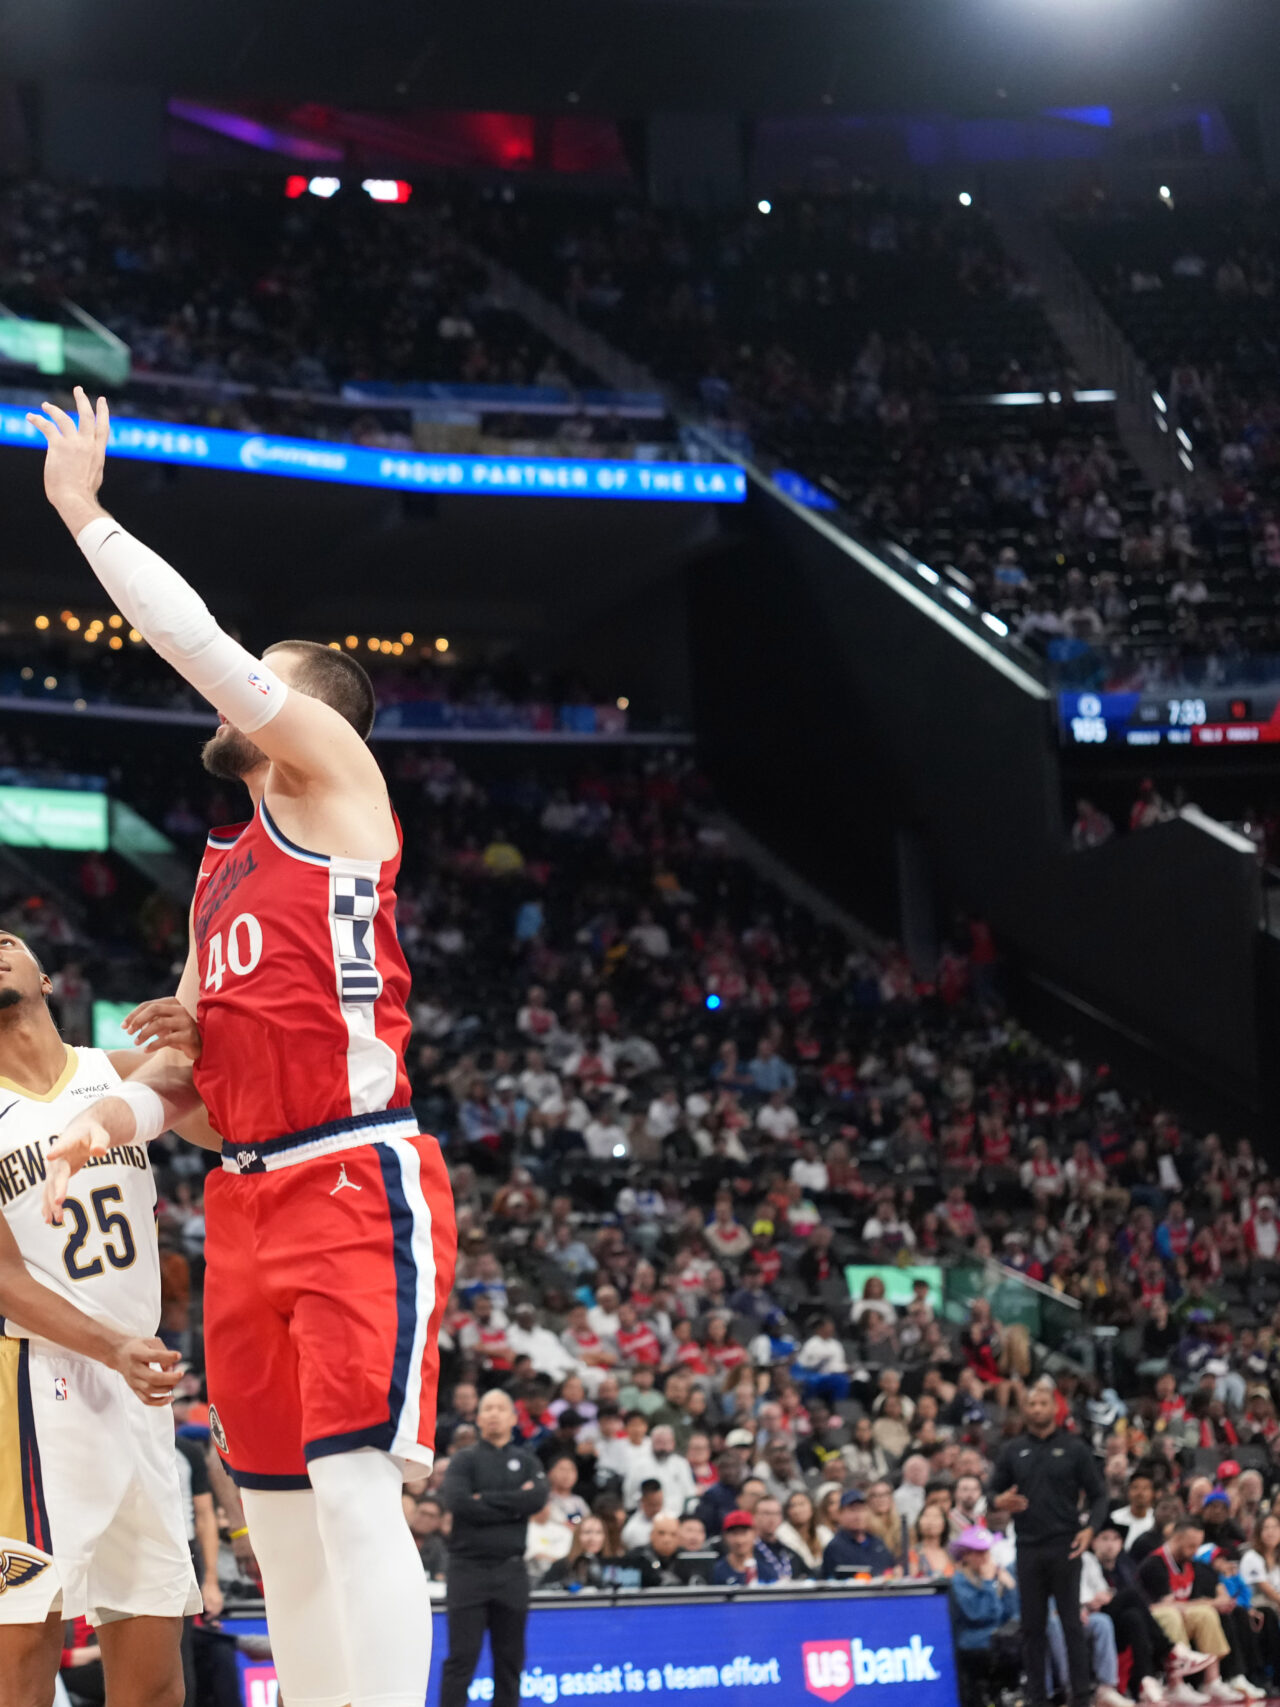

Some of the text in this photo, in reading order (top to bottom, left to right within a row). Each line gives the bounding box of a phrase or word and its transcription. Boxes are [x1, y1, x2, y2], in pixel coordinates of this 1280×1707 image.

[380, 458, 463, 484] PROUD
[472, 463, 587, 489] PARTNER
[596, 468, 627, 490] OF
[639, 469, 684, 493] THE
[694, 474, 726, 493] LA
[204, 912, 263, 993] 40
[50, 1183, 138, 1283] 25
[519, 1666, 558, 1704] big
[559, 1663, 624, 1695] assist
[624, 1661, 645, 1691] is
[646, 1668, 663, 1691] a
[663, 1663, 719, 1690] team
[720, 1656, 781, 1687] effort
[851, 1634, 937, 1686] bank
